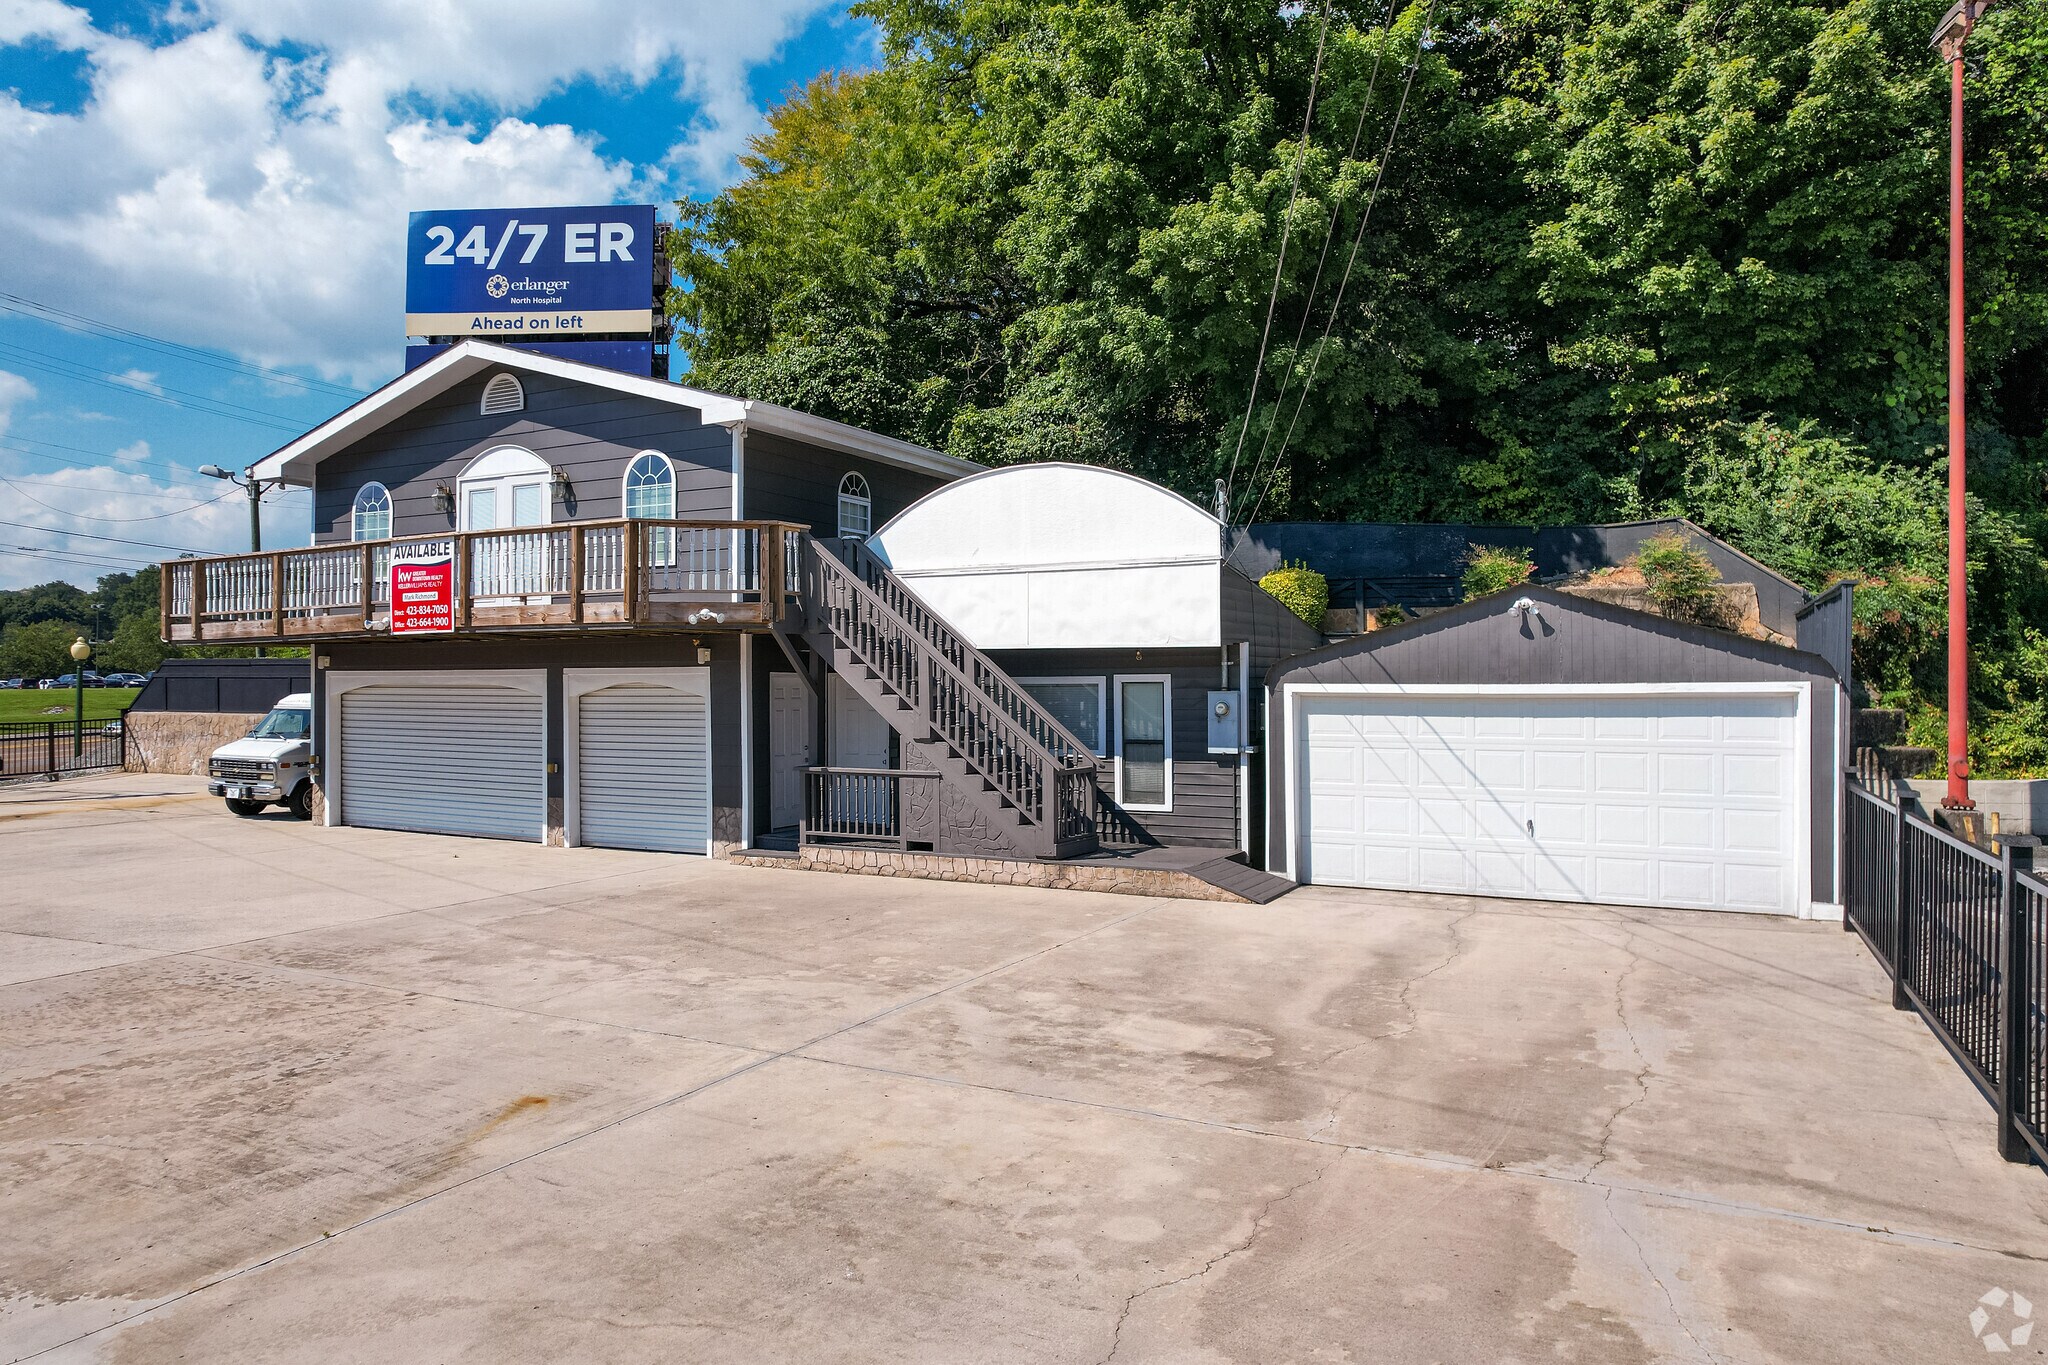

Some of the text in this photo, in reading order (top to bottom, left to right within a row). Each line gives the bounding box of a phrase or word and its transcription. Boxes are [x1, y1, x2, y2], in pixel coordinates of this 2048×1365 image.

[425, 220, 635, 269] 24/7 ER
[511, 276, 570, 294] erlanger
[510, 296, 562, 305] North Hospital
[471, 315, 583, 330] Ahead on left
[394, 542, 450, 559] AVAILABLE
[398, 568, 413, 583] kw
[415, 592, 437, 600] Richmond
[406, 604, 448, 615] 423-834-7050
[406, 617, 449, 628] 423-664-1900
